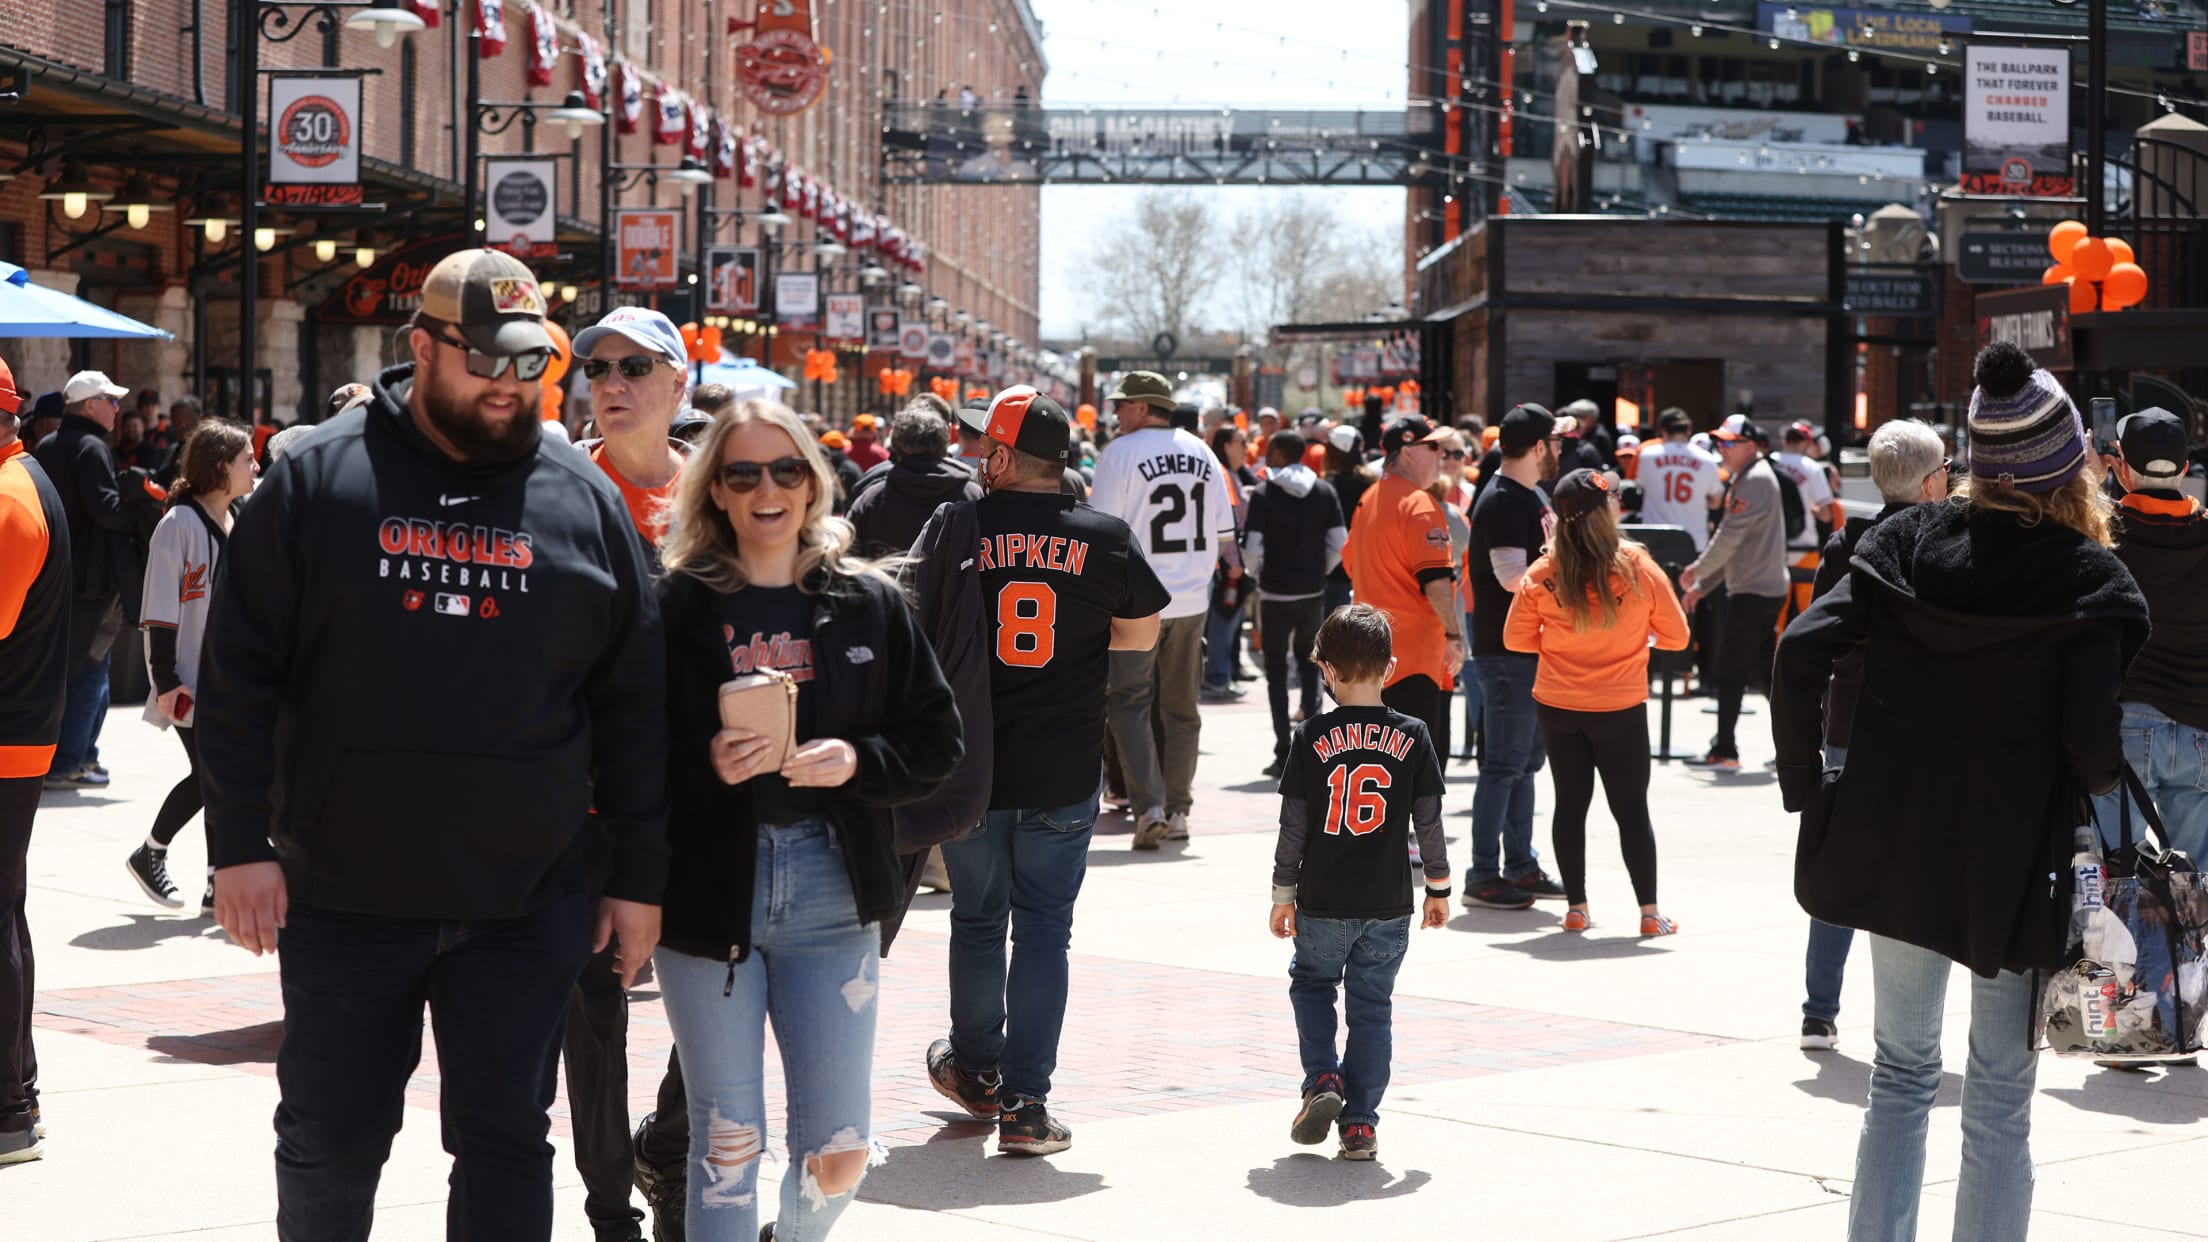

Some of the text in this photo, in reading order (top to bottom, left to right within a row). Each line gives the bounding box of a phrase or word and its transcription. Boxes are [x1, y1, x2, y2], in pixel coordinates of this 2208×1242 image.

[1976, 61, 2059, 75] THE BALLPARK
[1976, 78, 2059, 92] THAT FOREVER
[1985, 95, 2048, 108] CHANGED
[1986, 111, 2048, 124] BASEBALL.
[295, 112, 333, 142] 30
[1988, 256, 2050, 269] BLEACHER
[1138, 454, 1211, 482] CLEMENTE
[1664, 471, 1694, 503] 16
[1149, 482, 1206, 554] 21
[379, 516, 533, 569] ORIOLES
[978, 533, 1088, 576] RIPKEN
[379, 558, 529, 593] BASEBALL
[997, 581, 1056, 669] 8
[1313, 723, 1415, 763] MANCINI
[1324, 764, 1392, 836] 16
[2080, 866, 2101, 908] hint
[2083, 989, 2103, 1035] hint
